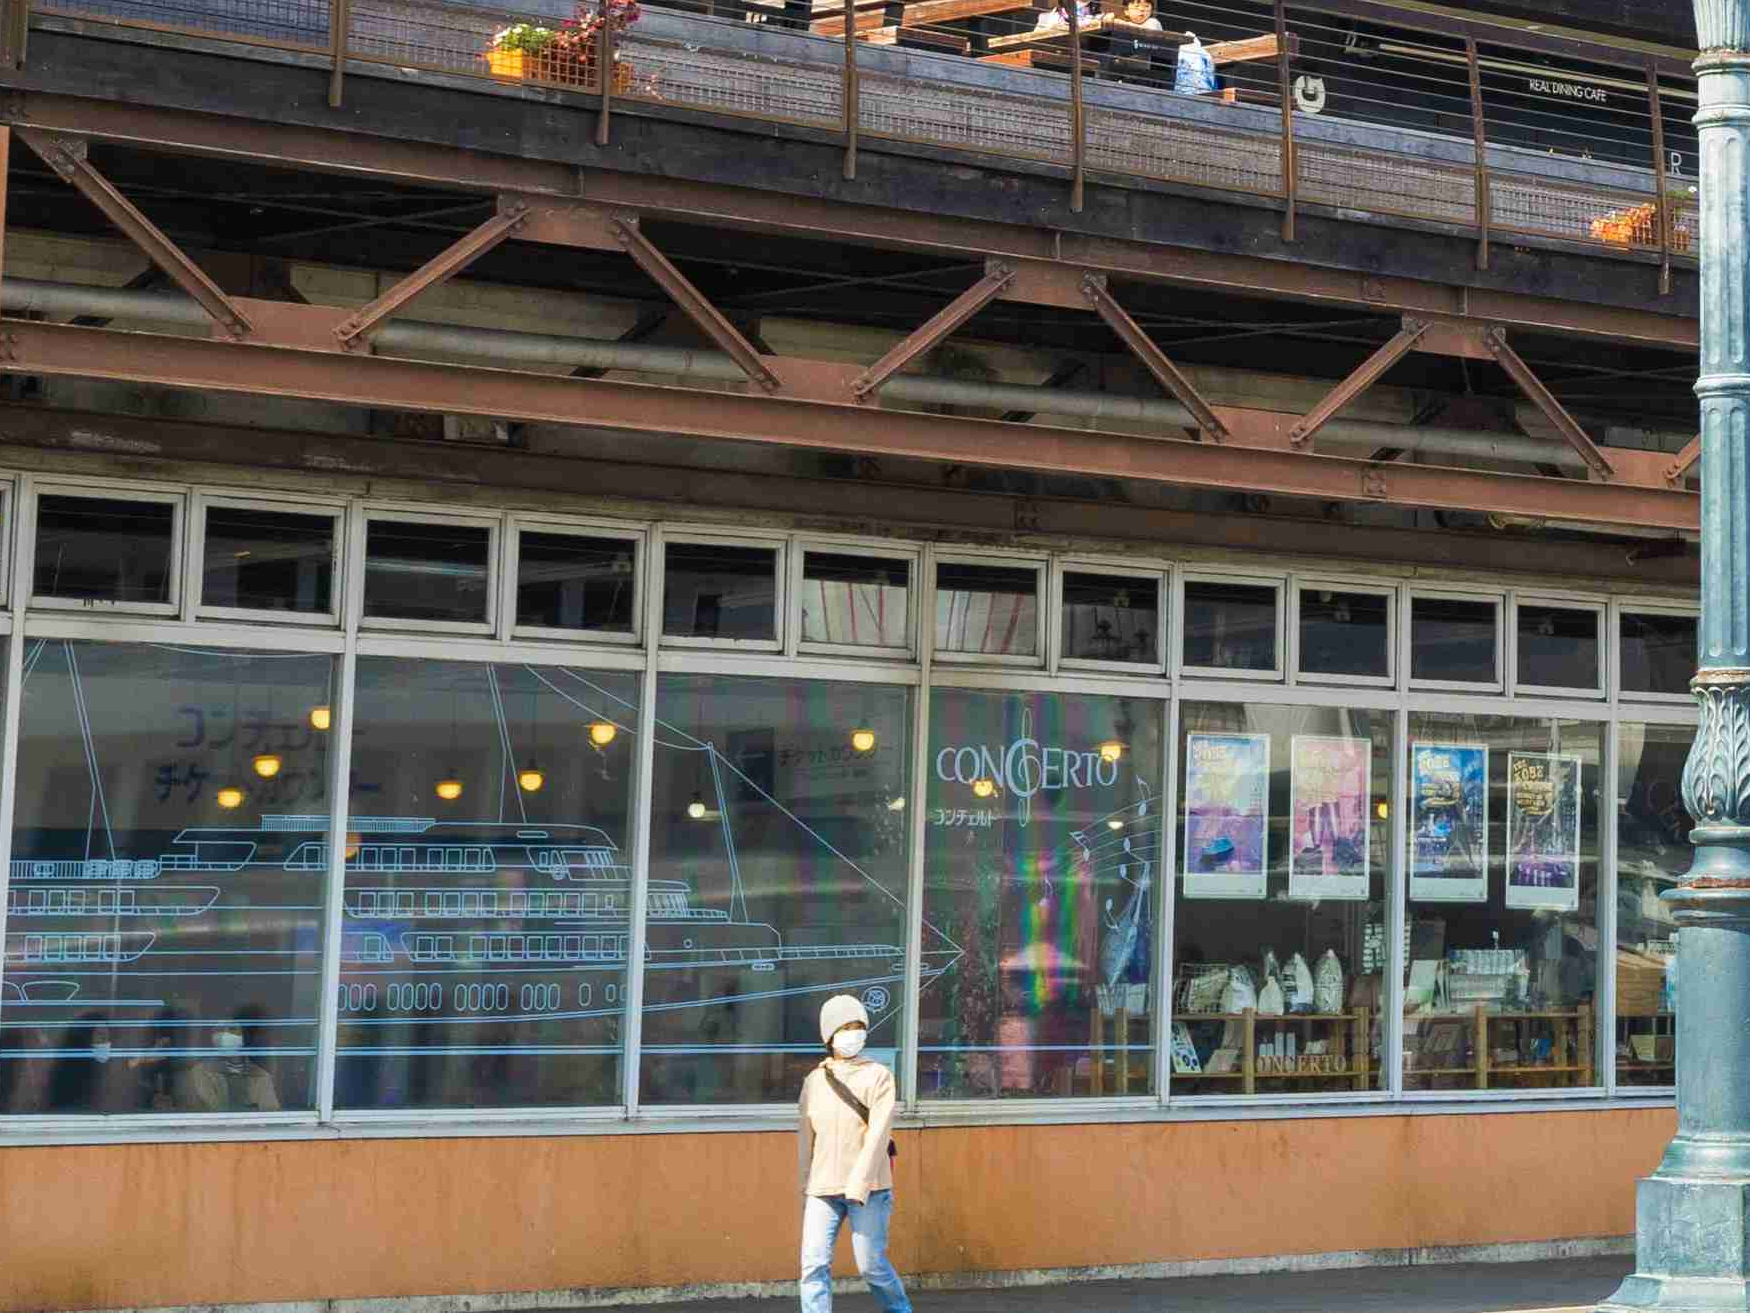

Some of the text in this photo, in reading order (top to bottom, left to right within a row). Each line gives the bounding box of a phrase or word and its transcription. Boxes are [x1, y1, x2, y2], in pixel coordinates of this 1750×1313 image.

[1552, 81, 1584, 98] DINING
[1583, 86, 1608, 103] CAFE
[936, 737, 1118, 799] CONCERTO
[934, 808, 997, 828] コンチェルト
